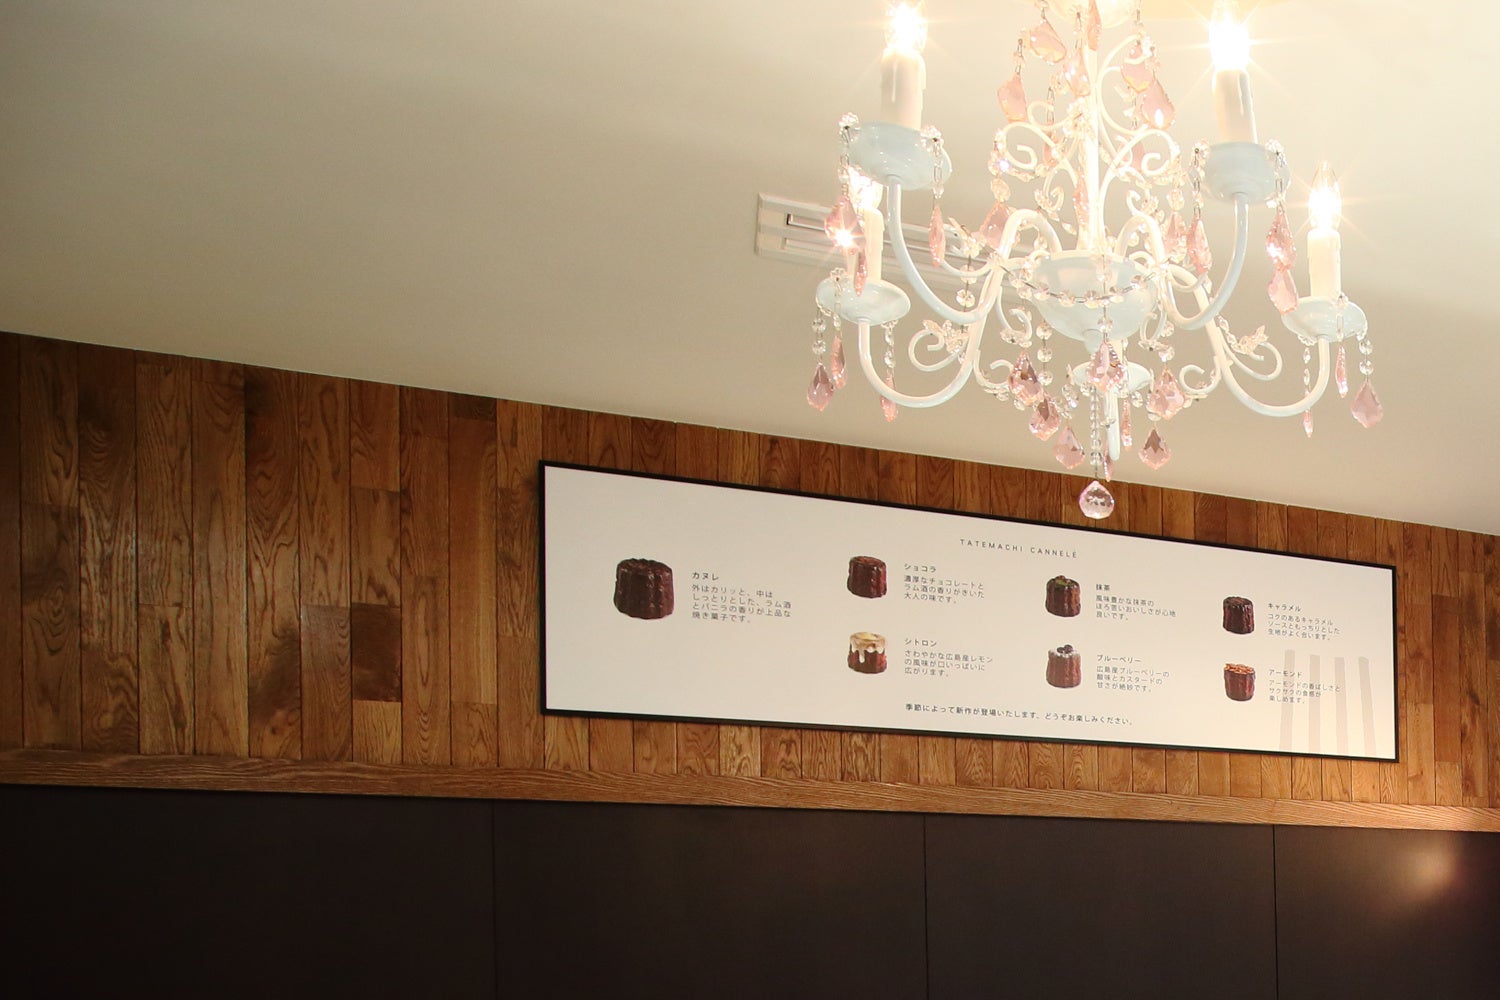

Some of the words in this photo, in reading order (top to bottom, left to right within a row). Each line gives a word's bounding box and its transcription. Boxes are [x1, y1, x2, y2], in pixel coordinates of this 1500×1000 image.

[960, 539, 1023, 552] TATEMACHI
[904, 563, 936, 573] ショコラ
[692, 572, 719, 581] カヌレ
[1268, 603, 1301, 612] キャラメル
[904, 638, 937, 647] シトロン
[1097, 654, 1142, 664] ブルーベリー
[1269, 669, 1304, 678] アーモンド
